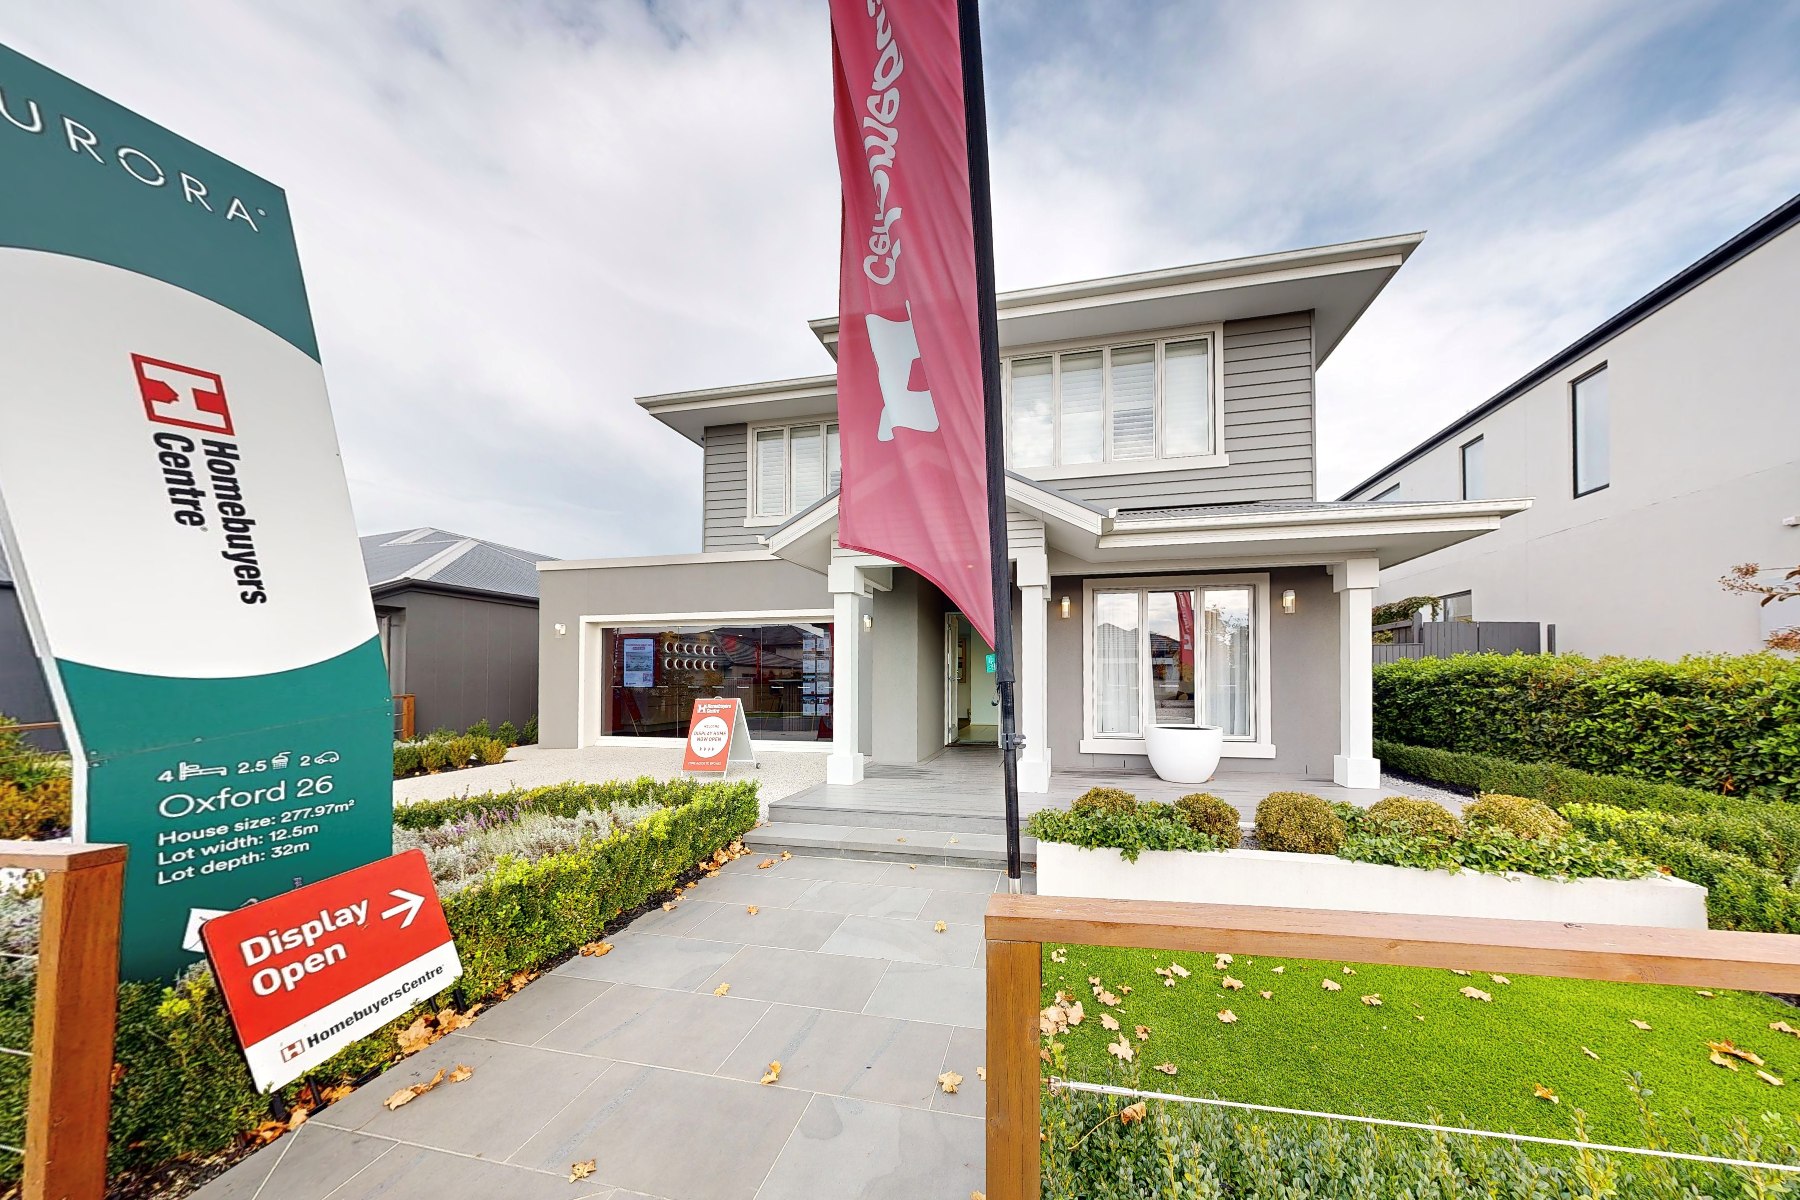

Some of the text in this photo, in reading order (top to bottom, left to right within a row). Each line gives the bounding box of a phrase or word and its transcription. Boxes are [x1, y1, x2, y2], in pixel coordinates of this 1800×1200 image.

[153, 432, 206, 527] Centre
[201, 438, 267, 605] Homebuyers
[157, 755, 311, 783] 4 2.5 2
[158, 775, 333, 818] Oxford 26
[158, 824, 229, 846] House
[234, 816, 276, 833] size:
[158, 823, 319, 865] Lot width: 12.5m
[158, 842, 310, 885] Lot depth: 32m
[239, 899, 369, 967] Display
[251, 943, 348, 997] Open
